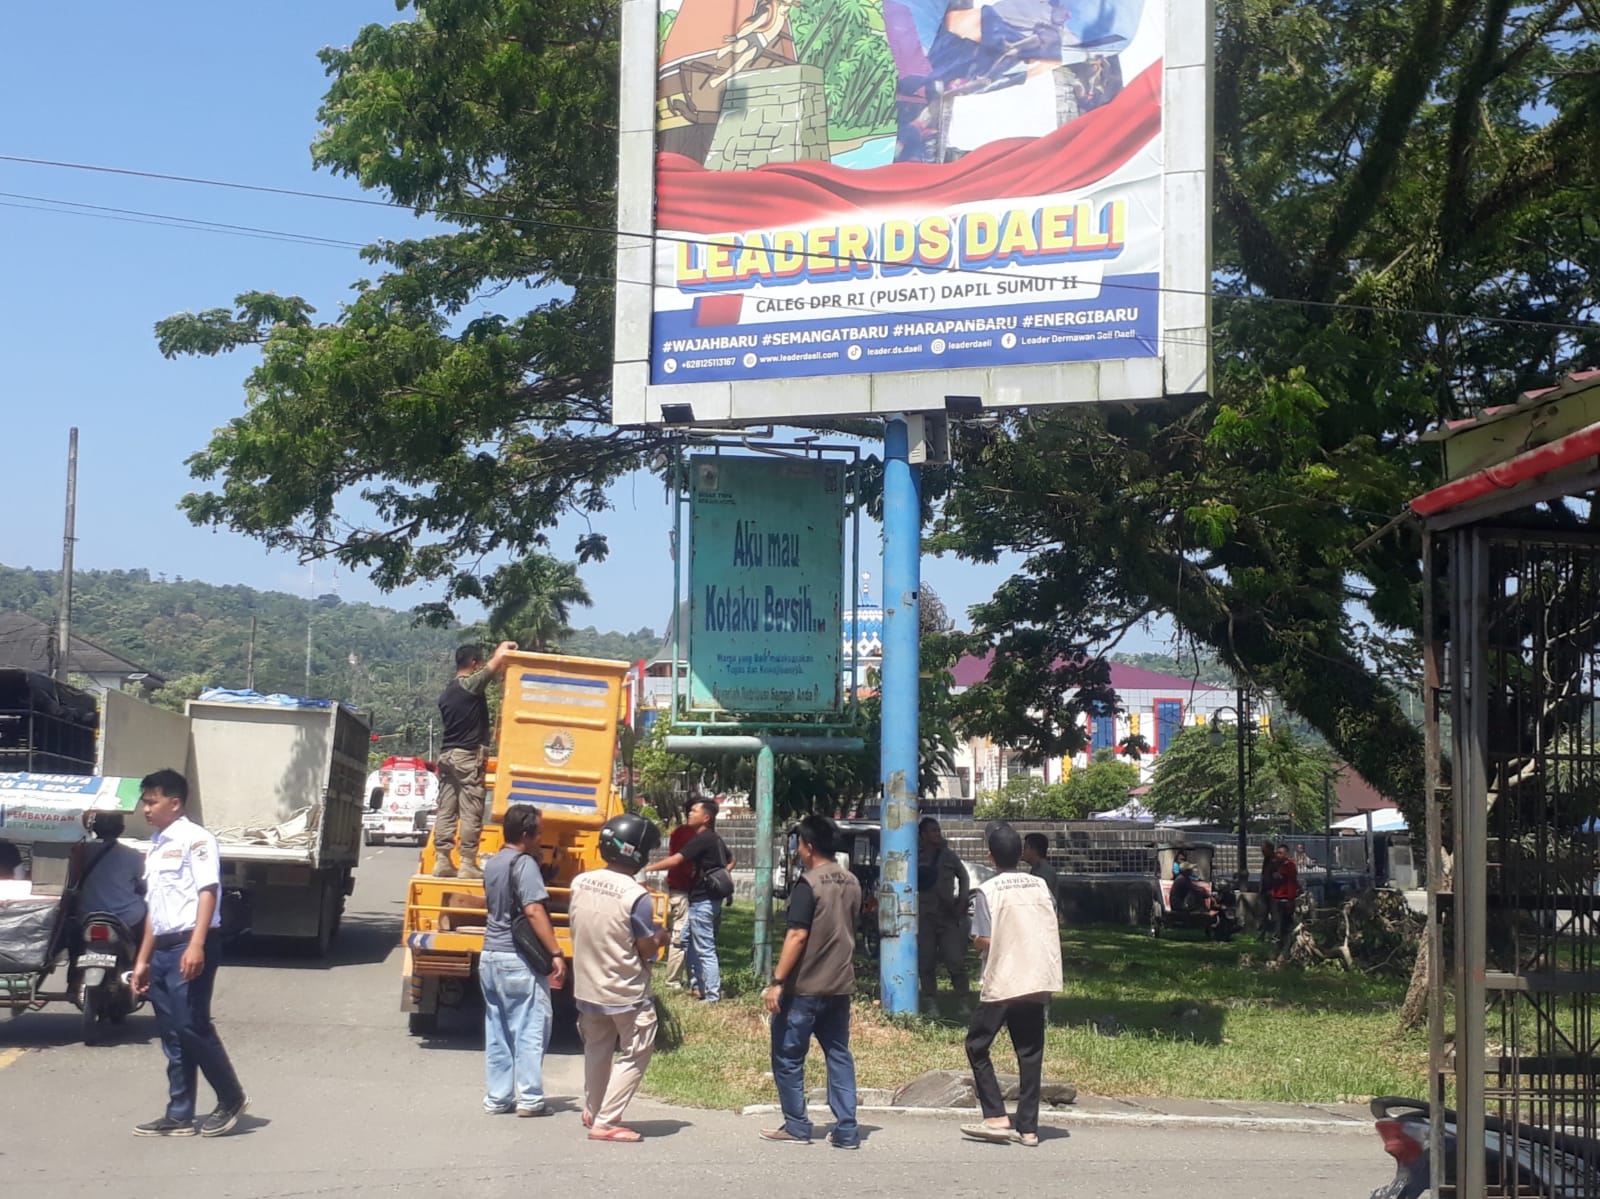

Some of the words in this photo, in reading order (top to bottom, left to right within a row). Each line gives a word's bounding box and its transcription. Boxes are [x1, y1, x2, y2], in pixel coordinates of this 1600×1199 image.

[676, 224, 872, 288] LEADER
[880, 215, 951, 275] DS
[961, 200, 1125, 266] DAELI
[756, 299, 805, 313] CALEG
[810, 295, 842, 310] DPR
[848, 293, 865, 306] RI
[870, 286, 936, 307] (PUSAT)
[941, 284, 992, 299] DAPIL
[997, 278, 1057, 295] SUMUT
[1062, 276, 1078, 290] II
[662, 335, 758, 352] #WAJAHBARU
[762, 326, 889, 346] #SEMANGATBARU
[893, 316, 1018, 337] #HARAPANBARU
[1022, 308, 1139, 328] #ENERGIBARU
[1021, 336, 1050, 345] Leader
[1052, 334, 1095, 343] Dermawan
[733, 519, 763, 568] Aku
[768, 533, 800, 568] mau
[706, 584, 759, 632] Kotaku
[6, 809, 76, 822] PEMBAYARAN
